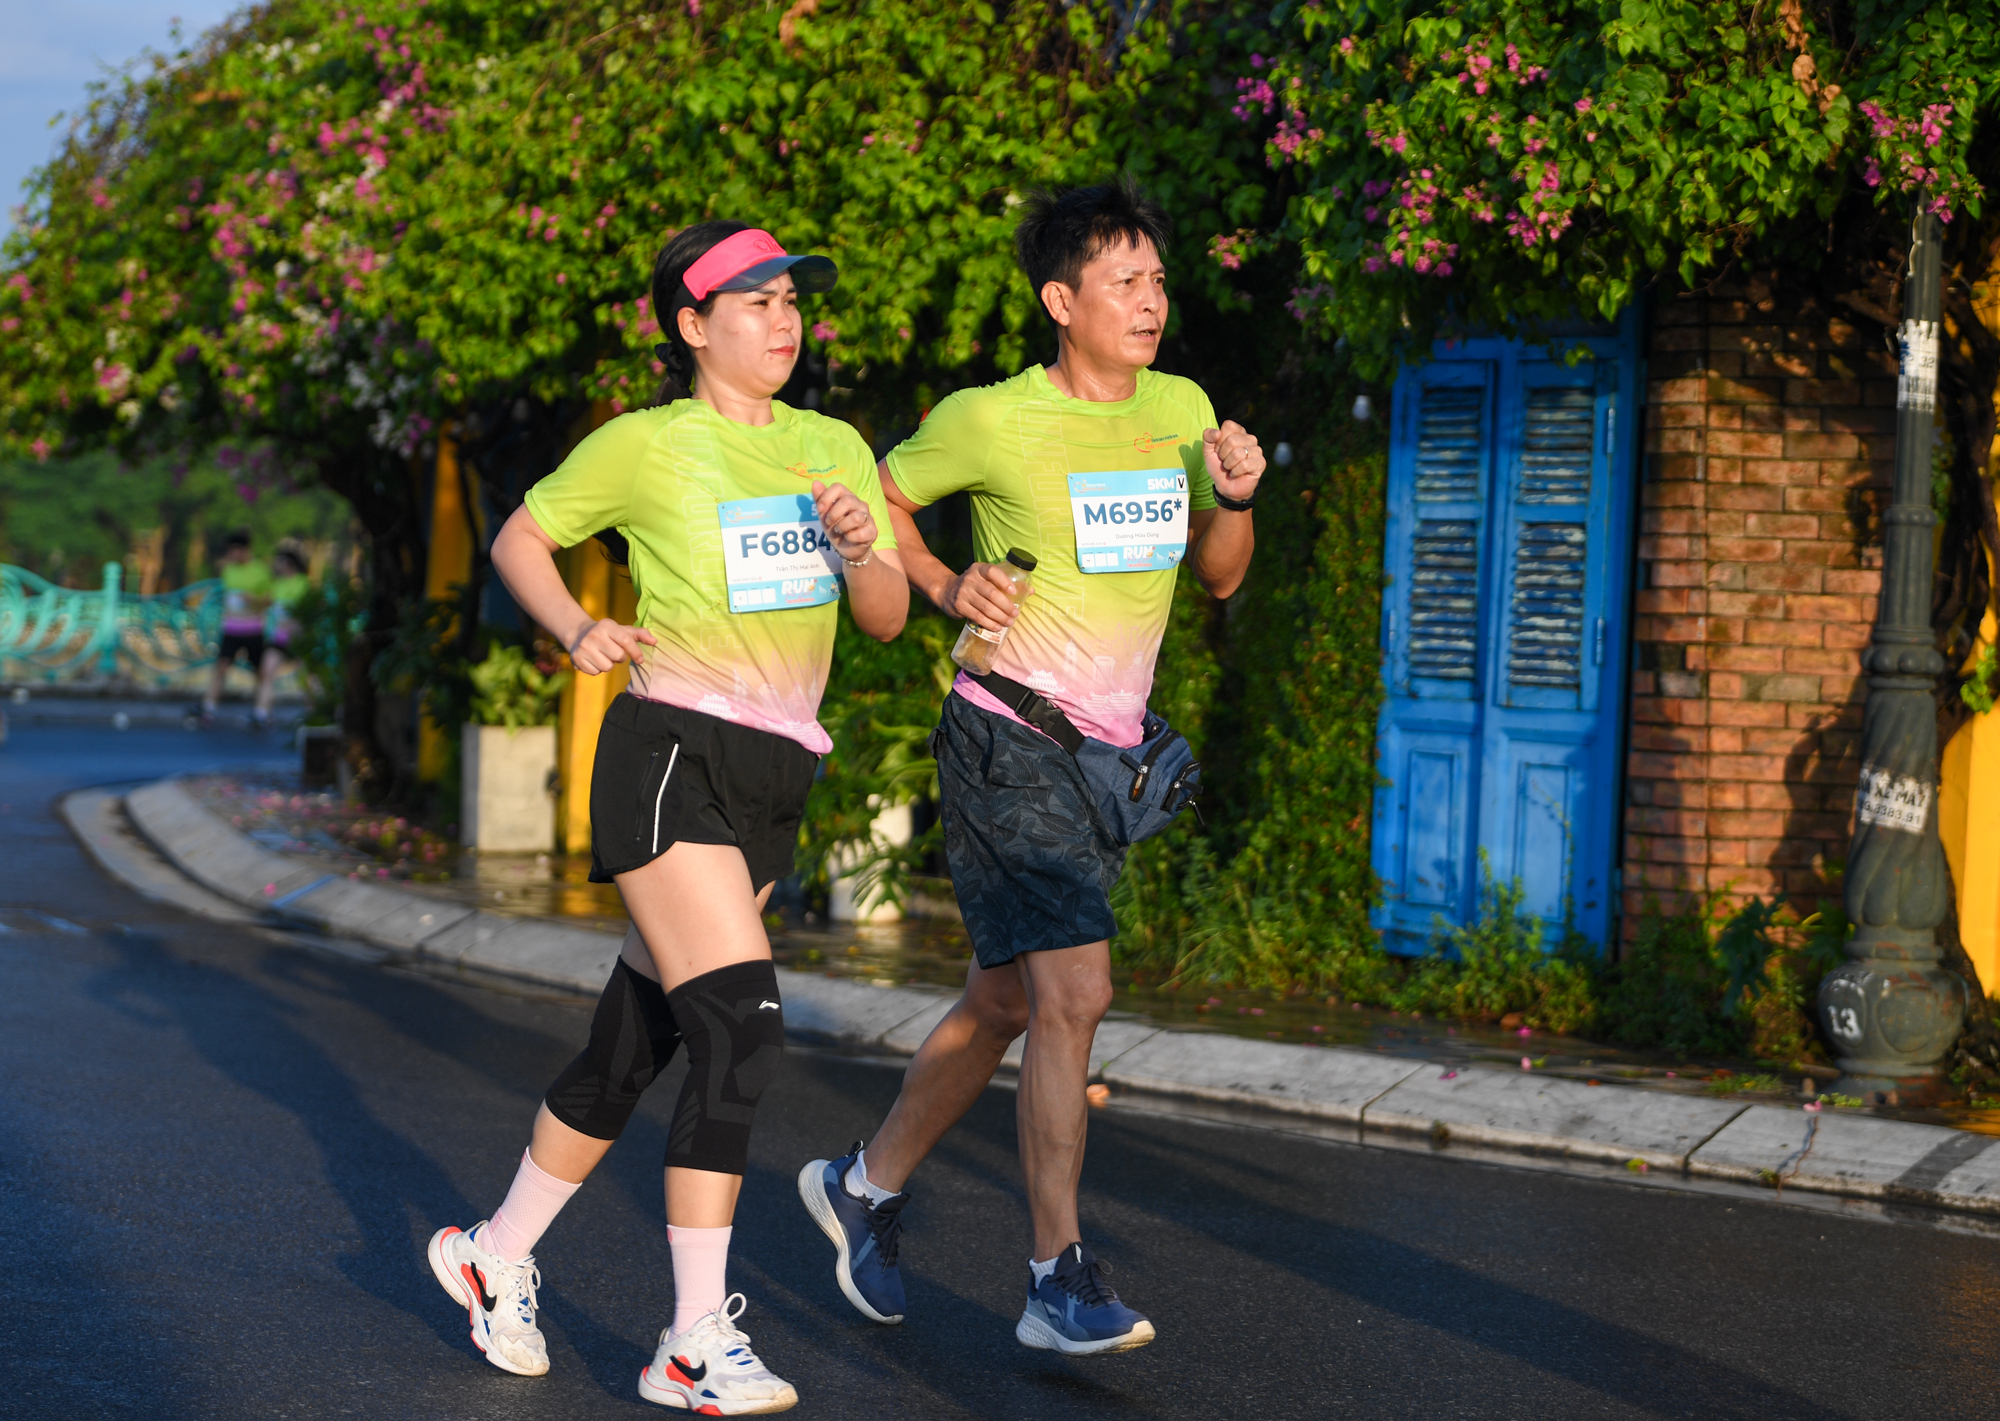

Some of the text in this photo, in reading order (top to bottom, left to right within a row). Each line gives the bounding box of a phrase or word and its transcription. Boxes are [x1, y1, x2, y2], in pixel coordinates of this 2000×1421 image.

[1147, 477, 1185, 491] 5KM V
[739, 527, 831, 559] F6884
[1123, 546, 1153, 559] RUN
[781, 578, 815, 595] RUN
